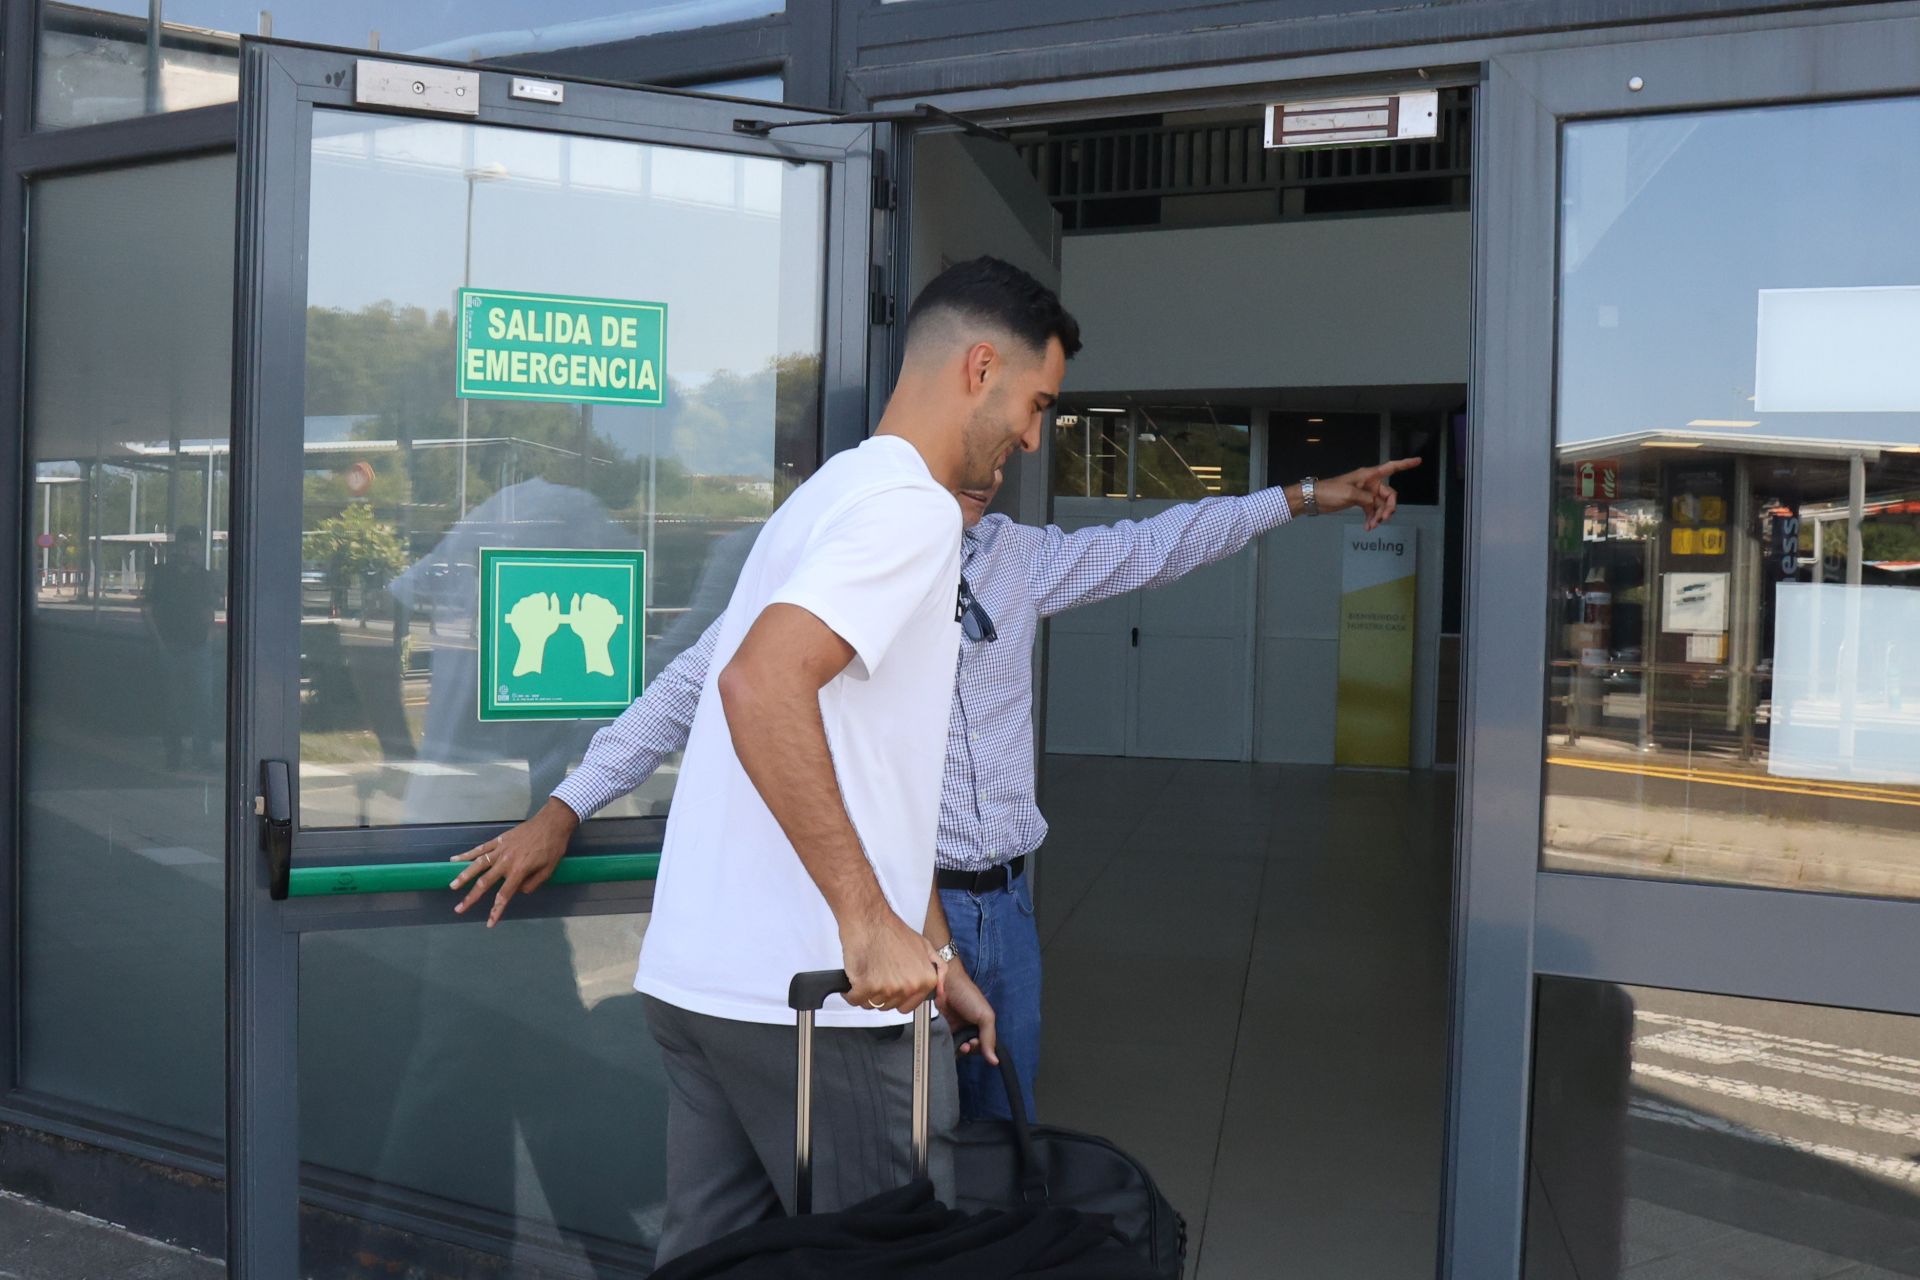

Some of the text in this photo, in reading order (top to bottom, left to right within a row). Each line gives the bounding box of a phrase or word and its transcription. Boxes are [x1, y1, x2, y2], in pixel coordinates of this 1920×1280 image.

[488, 307, 592, 345] SALIDA
[601, 315, 637, 348] DE
[467, 348, 656, 390] EMERGENCIA
[1352, 537, 1404, 556] vueling
